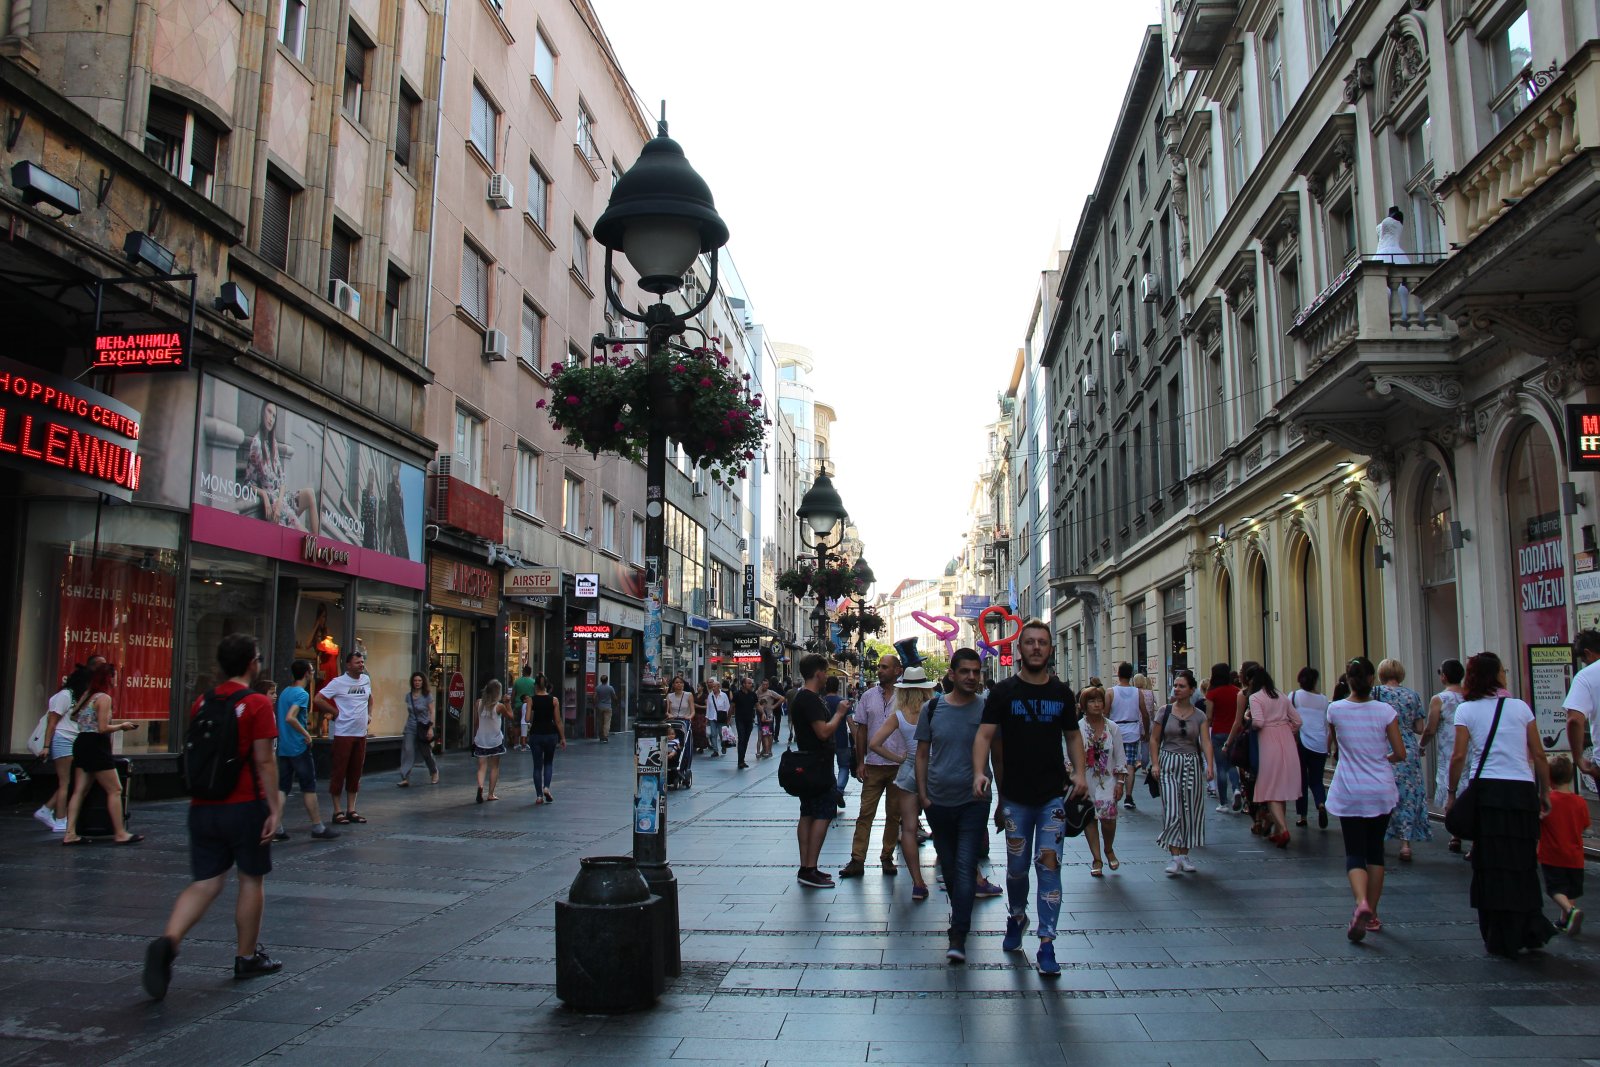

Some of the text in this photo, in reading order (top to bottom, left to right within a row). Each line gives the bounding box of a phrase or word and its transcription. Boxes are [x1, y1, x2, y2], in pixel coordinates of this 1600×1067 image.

[96, 333, 180, 350] МЕЊАЧНИЦА
[100, 349, 172, 361] EXCHANGE
[91, 404, 139, 440] CENTER
[1582, 415, 1600, 434] M
[200, 472, 258, 503] MONSOON
[325, 510, 365, 535] MONSOON
[452, 561, 493, 598] AIRSTEP
[513, 574, 551, 586] AIRSTEP
[67, 584, 122, 601] SNIŽENJE
[65, 627, 119, 643] SNIŽENJE
[1532, 649, 1571, 658] MENJAČNICA
